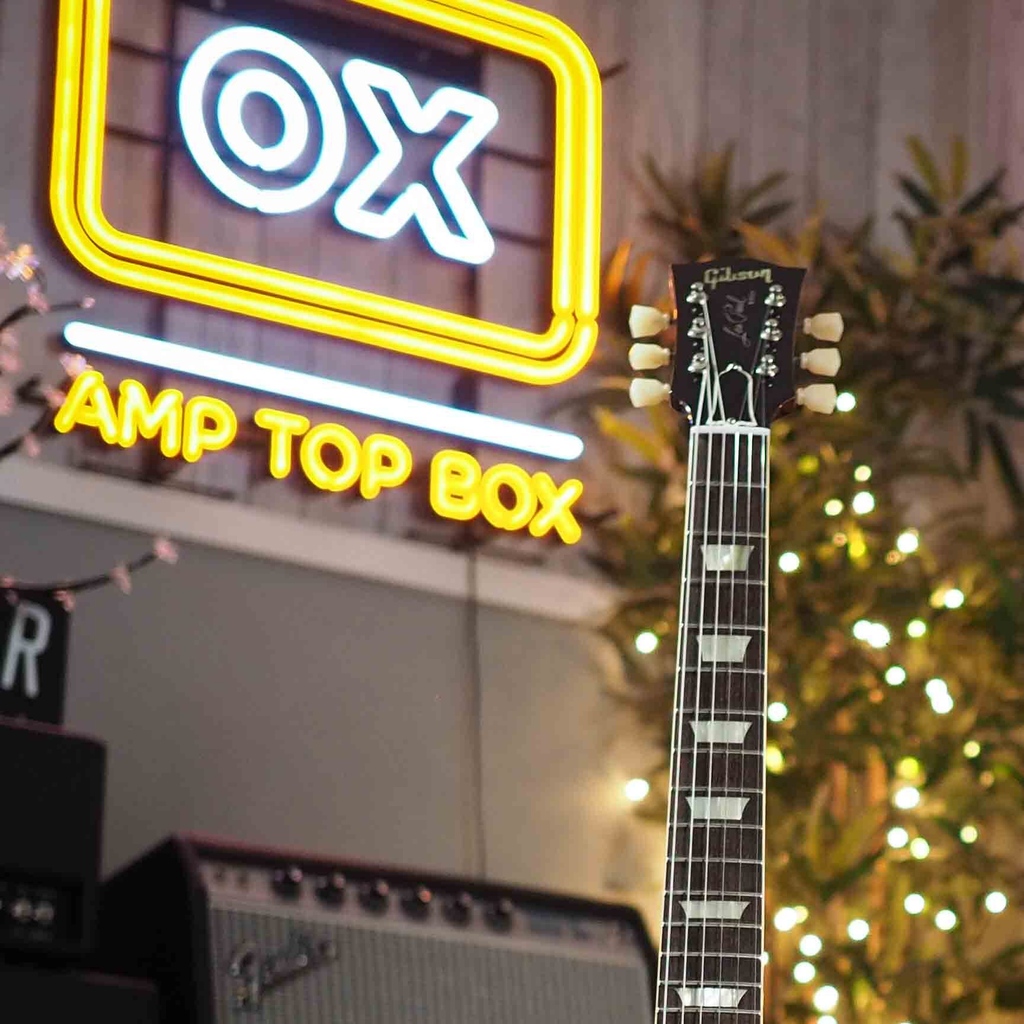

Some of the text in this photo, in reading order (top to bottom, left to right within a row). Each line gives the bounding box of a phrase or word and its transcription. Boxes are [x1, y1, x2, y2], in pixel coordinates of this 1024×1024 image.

[179, 25, 499, 265] OX
[703, 266, 773, 290] Gibson
[54, 371, 584, 545] AMP TOP BOX
